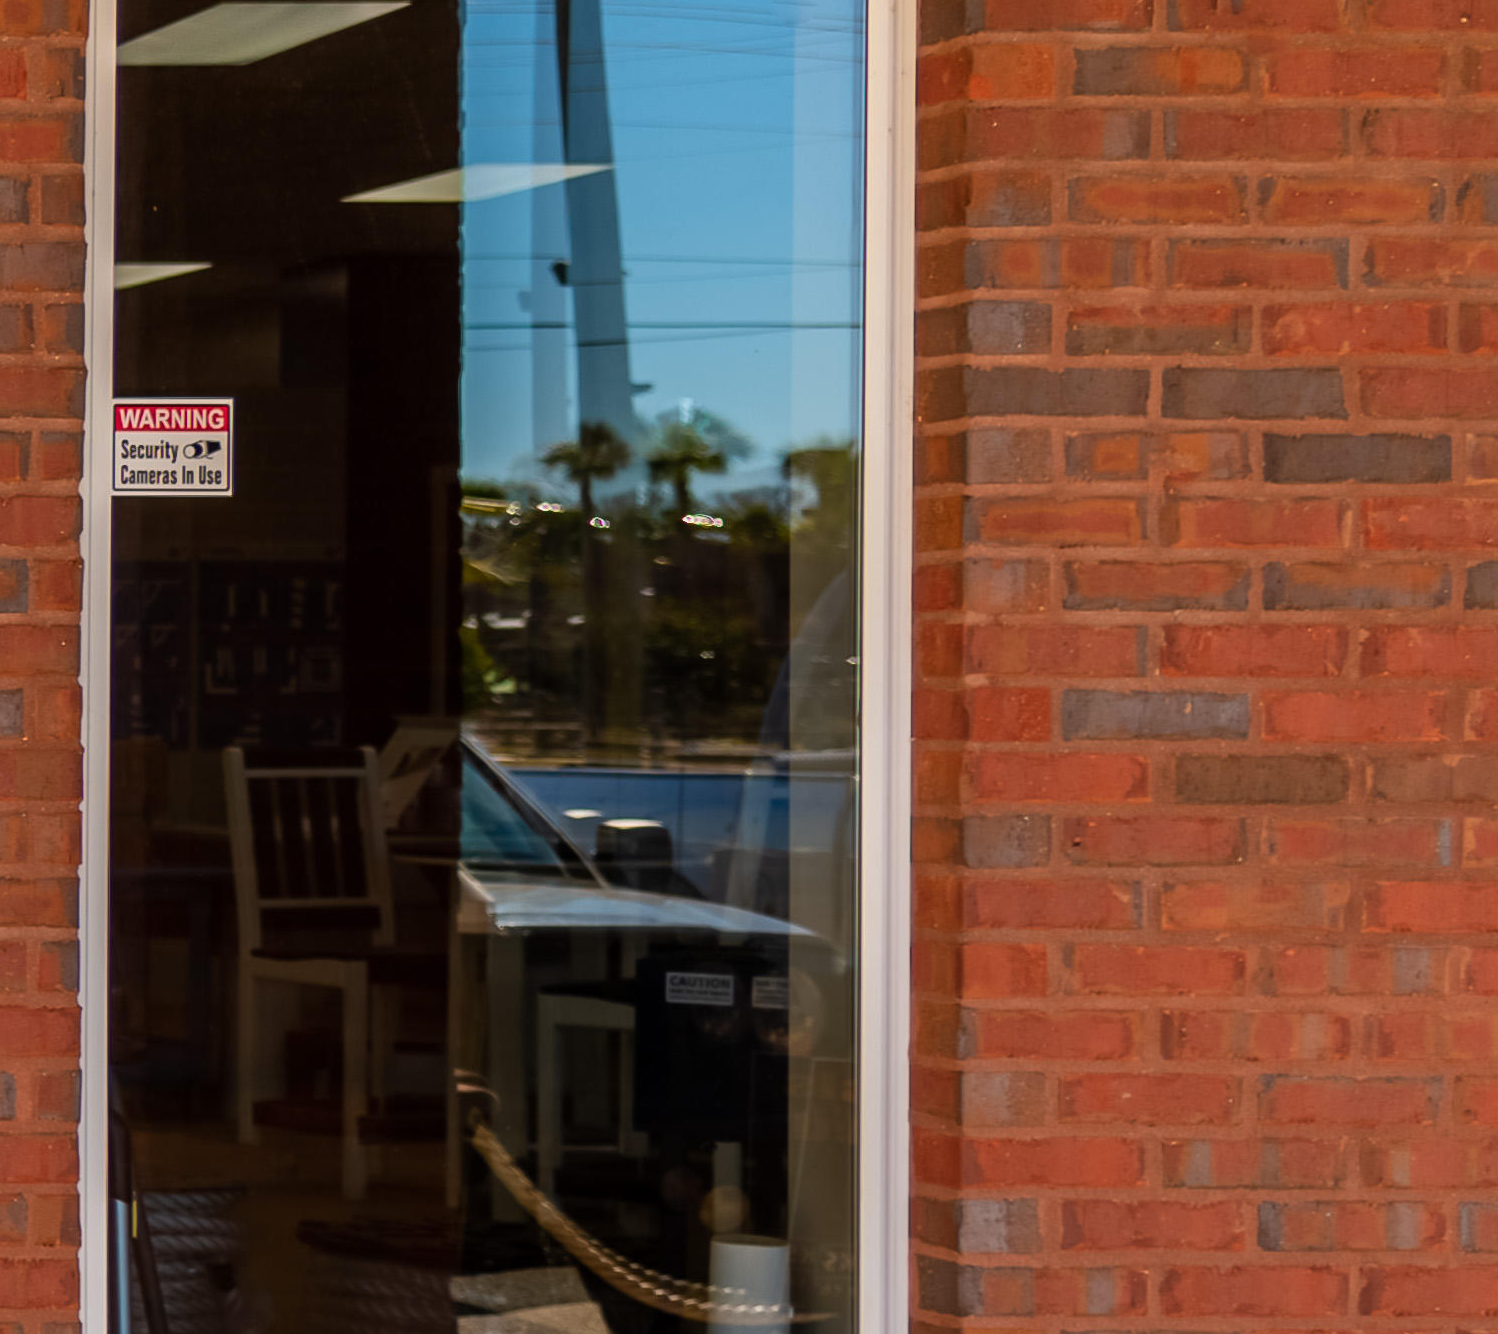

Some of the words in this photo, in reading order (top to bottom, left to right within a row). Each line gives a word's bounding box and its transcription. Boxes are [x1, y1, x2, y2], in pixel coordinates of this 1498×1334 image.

[119, 408, 225, 430] WARNING
[120, 439, 179, 464] Security
[120, 464, 178, 485] Cameras
[181, 465, 194, 485] In
[198, 465, 222, 485] Use
[668, 974, 732, 989] CAUTION
